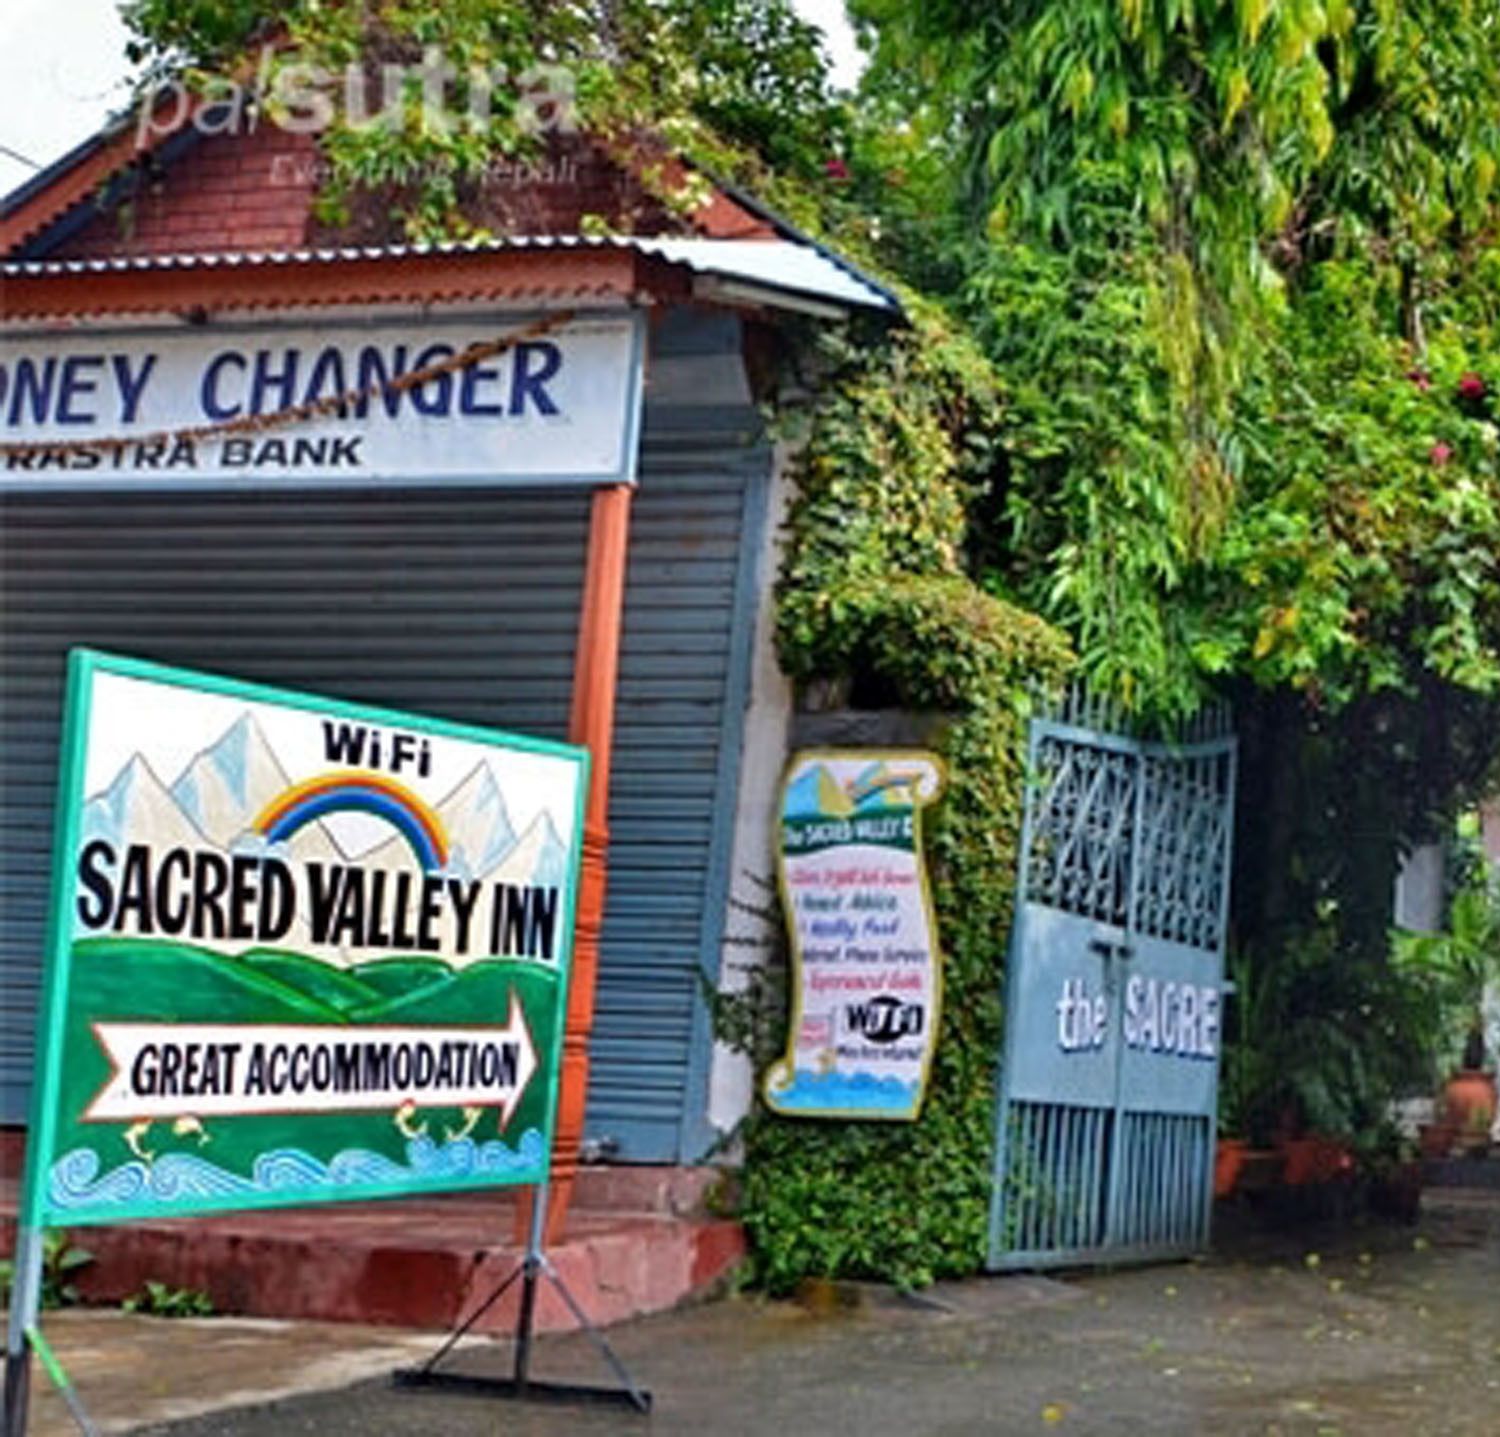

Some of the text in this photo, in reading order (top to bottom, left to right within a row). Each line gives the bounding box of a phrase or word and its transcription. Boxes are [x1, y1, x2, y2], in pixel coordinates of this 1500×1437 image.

[200, 338, 564, 421] CHANGER
[219, 436, 364, 467] BANK
[806, 824, 850, 844] SACRED
[856, 818, 899, 838] VALLEY
[77, 840, 558, 960] SACRED VALLEY INN
[1057, 972, 1219, 1061] the SACRE
[130, 1041, 521, 1097] GREAT ACCOMMODATION
